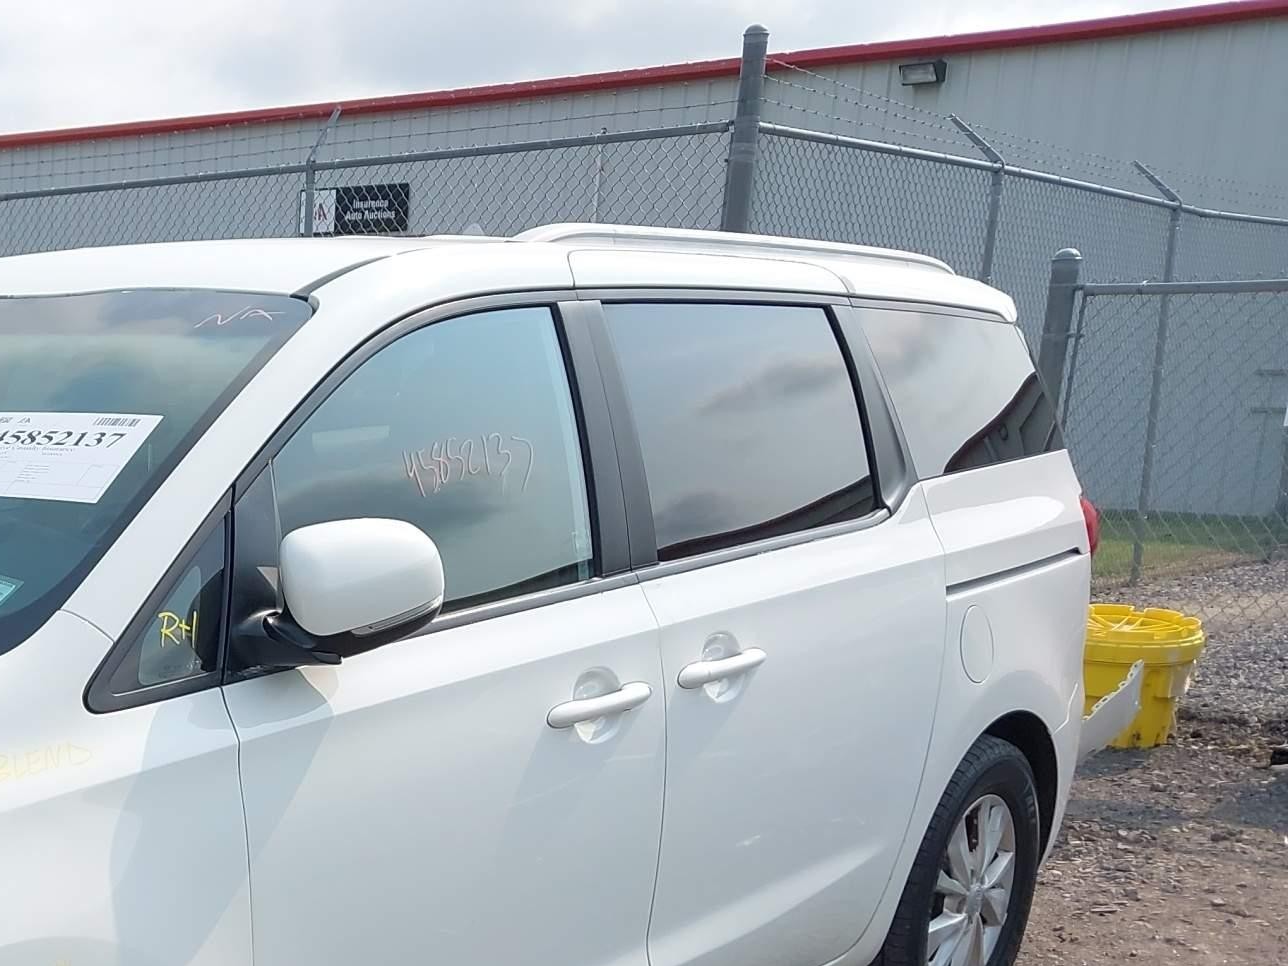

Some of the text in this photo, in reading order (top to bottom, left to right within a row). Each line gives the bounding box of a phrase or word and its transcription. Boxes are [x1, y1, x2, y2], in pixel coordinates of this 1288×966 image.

[345, 209, 396, 221] Auto Auctions
[402, 432, 535, 498] 45852137
